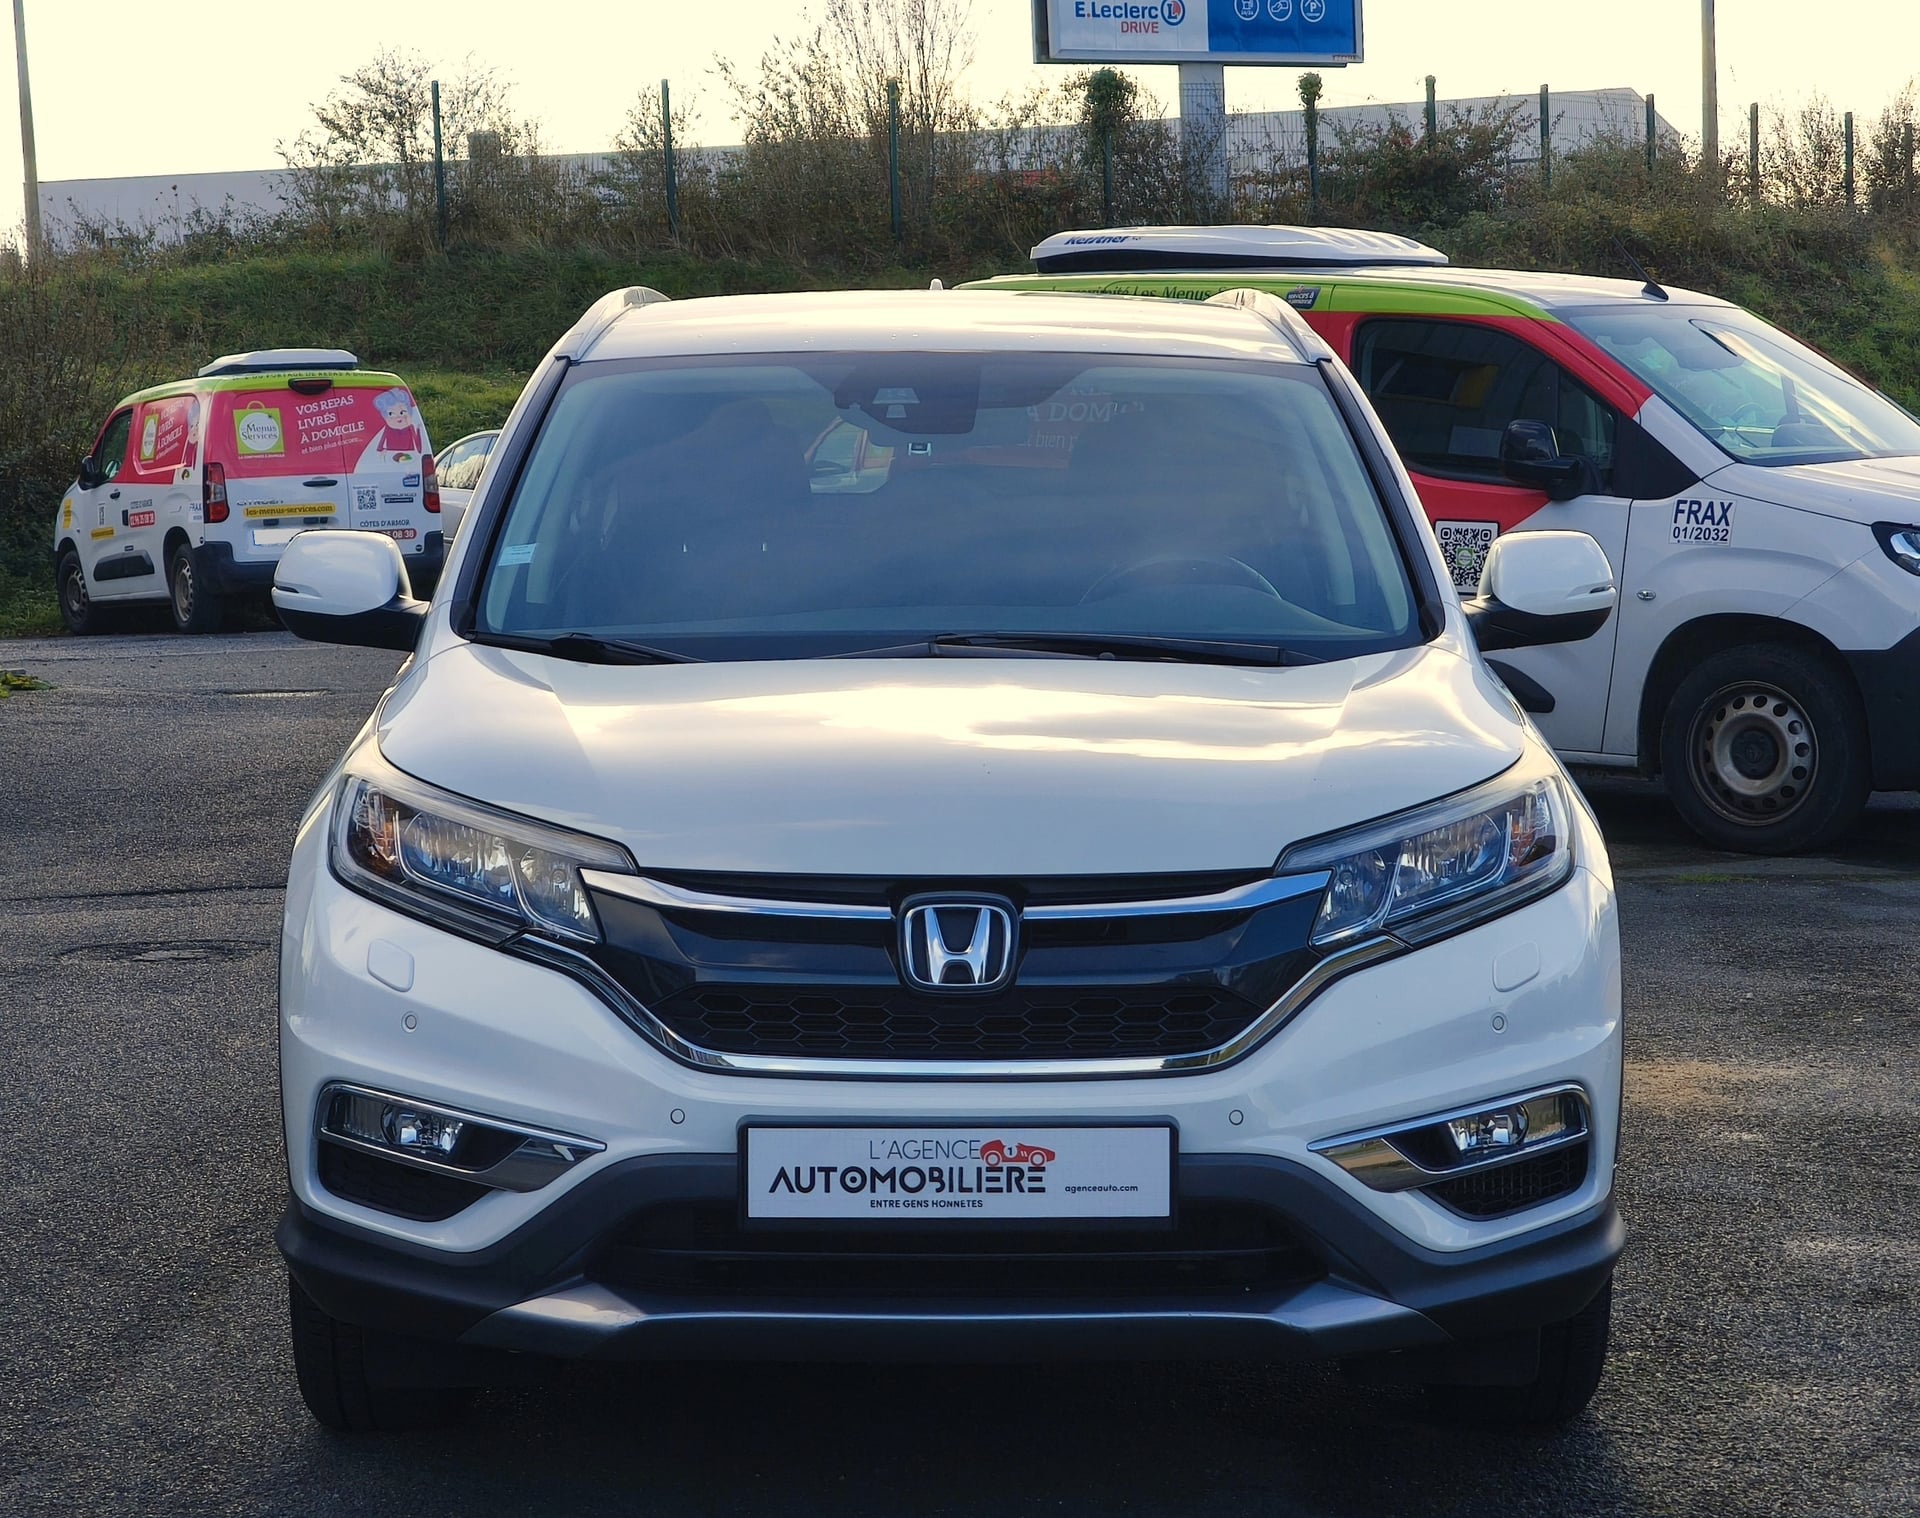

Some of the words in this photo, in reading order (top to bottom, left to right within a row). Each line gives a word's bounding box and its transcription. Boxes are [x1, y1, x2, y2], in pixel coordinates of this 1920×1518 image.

[1075, 1, 1159, 19] E.Leclerc
[1121, 21, 1160, 34] DRIVE
[1162, 286, 1211, 300] Menus
[296, 401, 320, 415] VOS
[320, 395, 354, 411] REPAS
[246, 423, 277, 432] Menus
[298, 412, 337, 430] LIVRÉS
[241, 431, 278, 441] Services
[301, 431, 310, 444] À
[311, 421, 365, 442] DOMICILE
[246, 505, 333, 516] les-menus-services.com
[1673, 499, 1733, 526] FRAX
[360, 519, 380, 528] CÔTES
[381, 519, 410, 527] D'ARMOR
[1673, 526, 1729, 542] 01/2032
[869, 1139, 982, 1160] L'AGENCE
[1064, 1184, 1139, 1194] agenceauto.com
[870, 1199, 901, 1208] ENTRE
[902, 1199, 929, 1208] GENS
